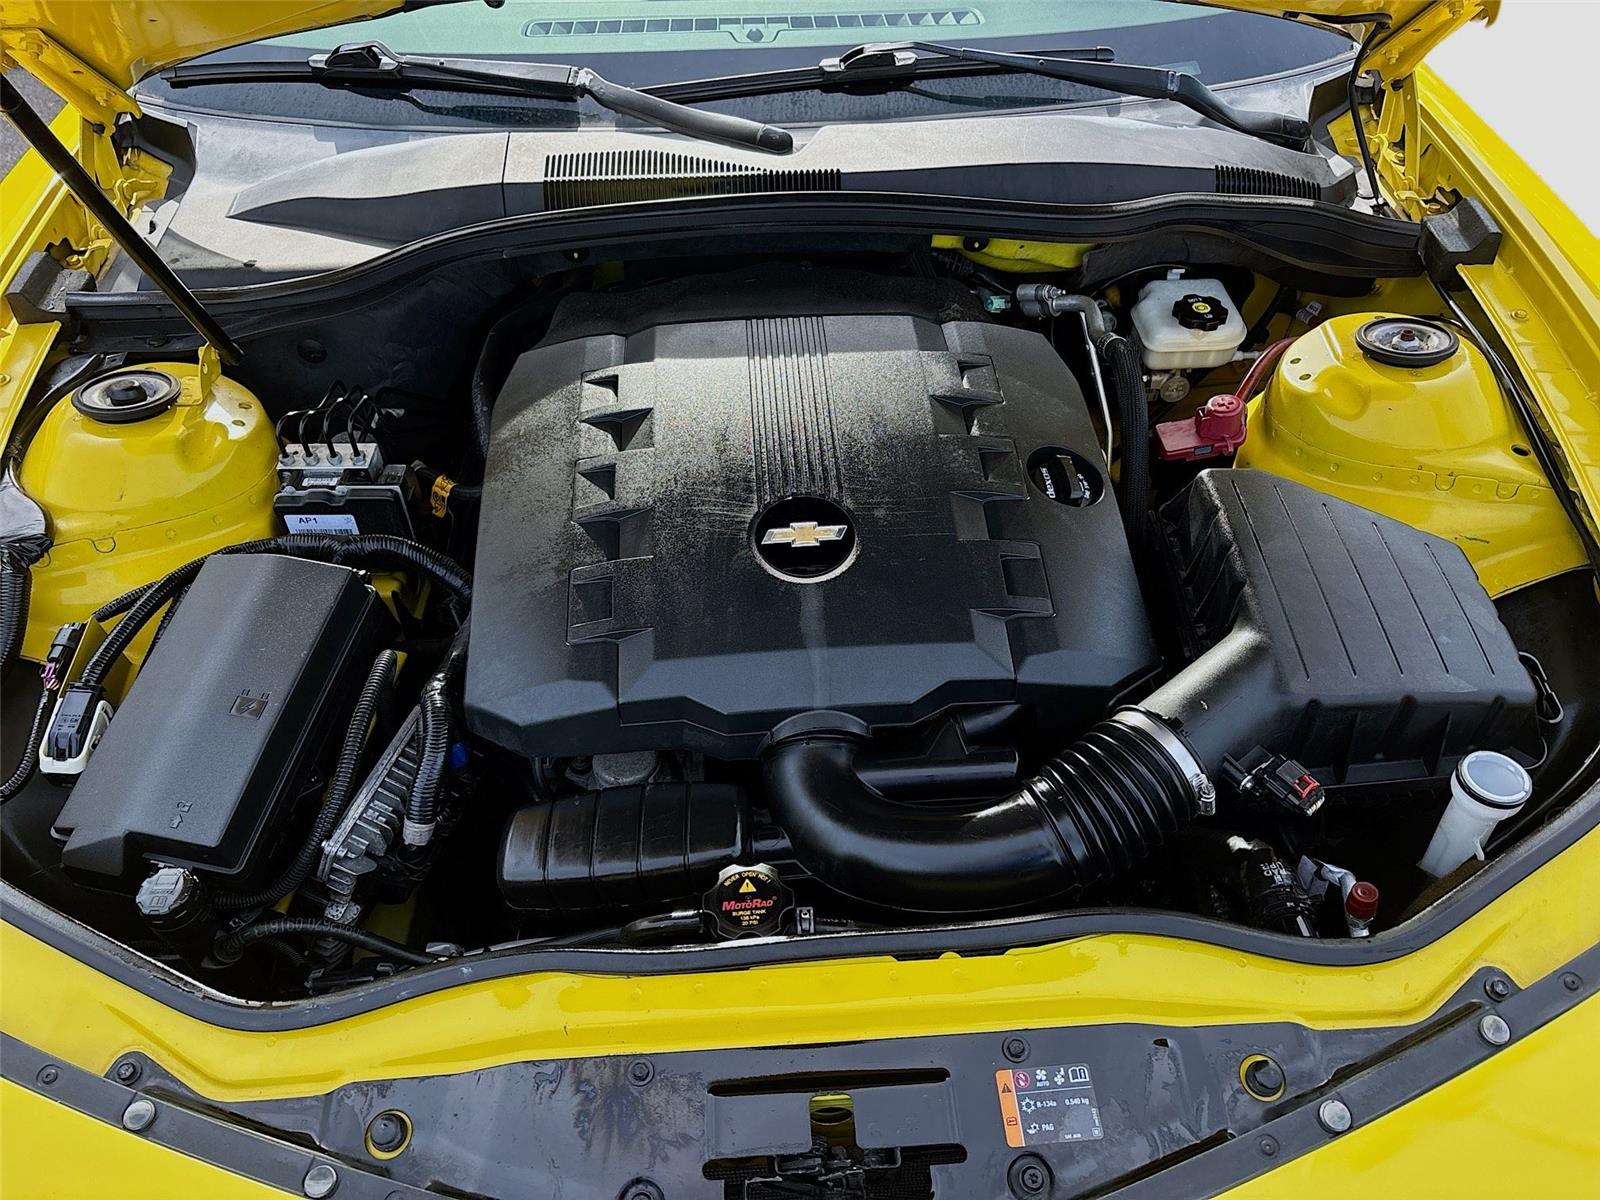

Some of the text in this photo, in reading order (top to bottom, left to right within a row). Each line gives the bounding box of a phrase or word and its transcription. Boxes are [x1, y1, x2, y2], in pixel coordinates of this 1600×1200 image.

[1040, 467, 1056, 498] dexos
[723, 874, 740, 887] NEVER
[1064, 1098, 1081, 1106] 0.540
[1080, 1097, 1090, 1105] kg
[1041, 1123, 1055, 1132] PAG
